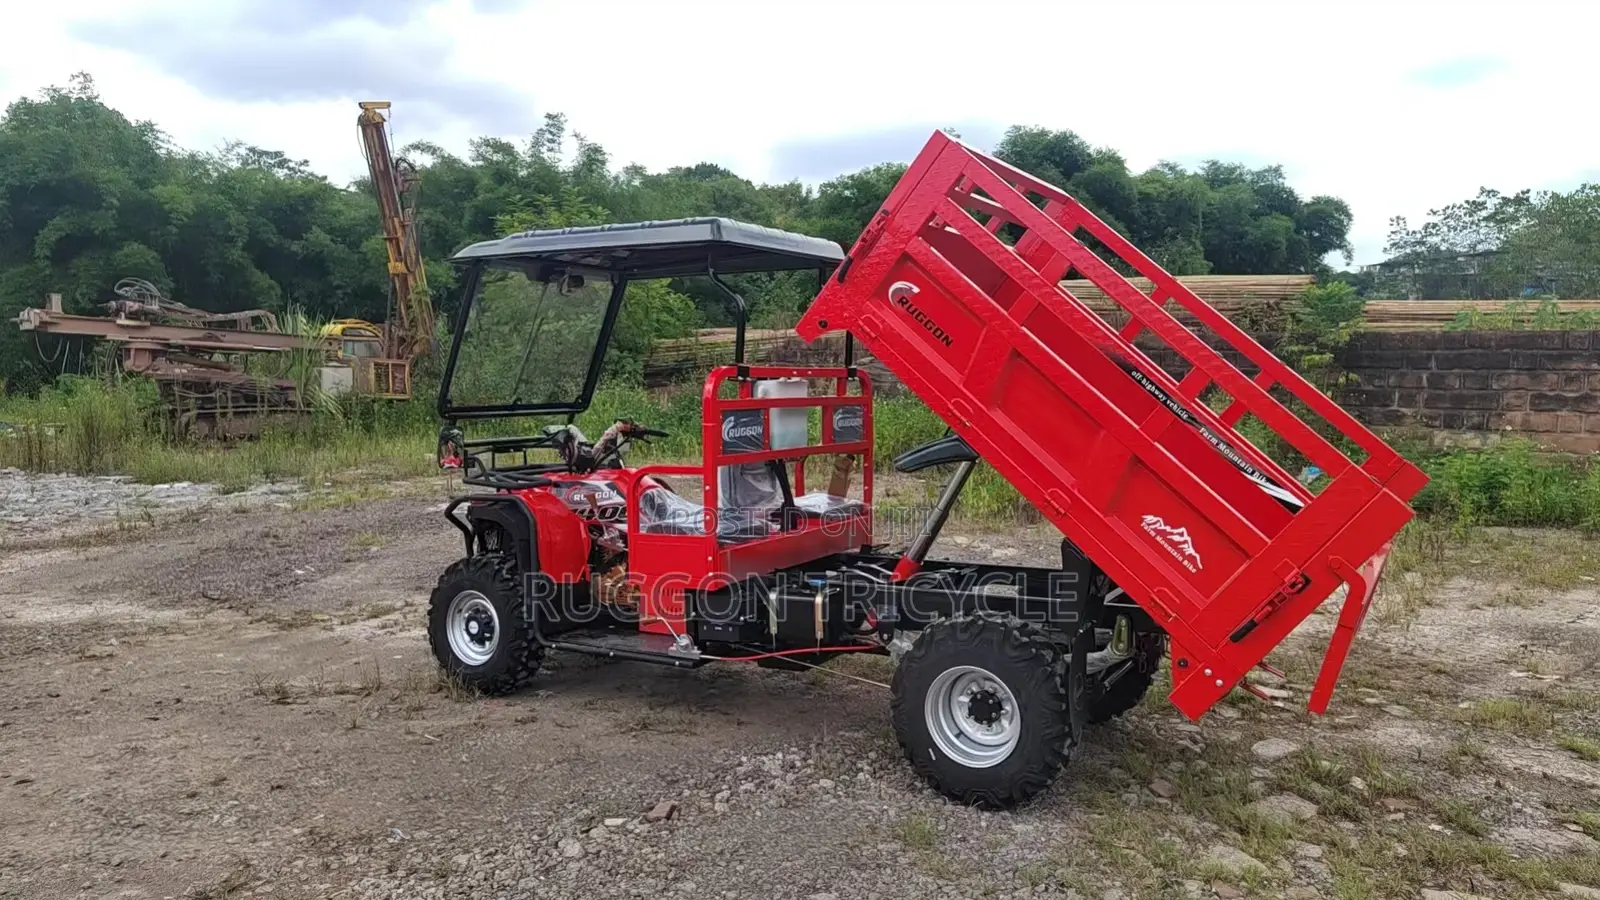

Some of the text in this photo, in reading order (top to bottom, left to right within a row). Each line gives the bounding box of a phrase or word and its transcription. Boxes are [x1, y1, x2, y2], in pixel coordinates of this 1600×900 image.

[897, 295, 954, 348] RUGGON
[1131, 370, 1189, 420] off-highway vehicle
[728, 425, 764, 438] RUGGON
[1199, 427, 1218, 446] Farm
[1217, 443, 1253, 474] Mountain
[1155, 535, 1183, 562] Mountain
[1182, 559, 1197, 573] Bike
